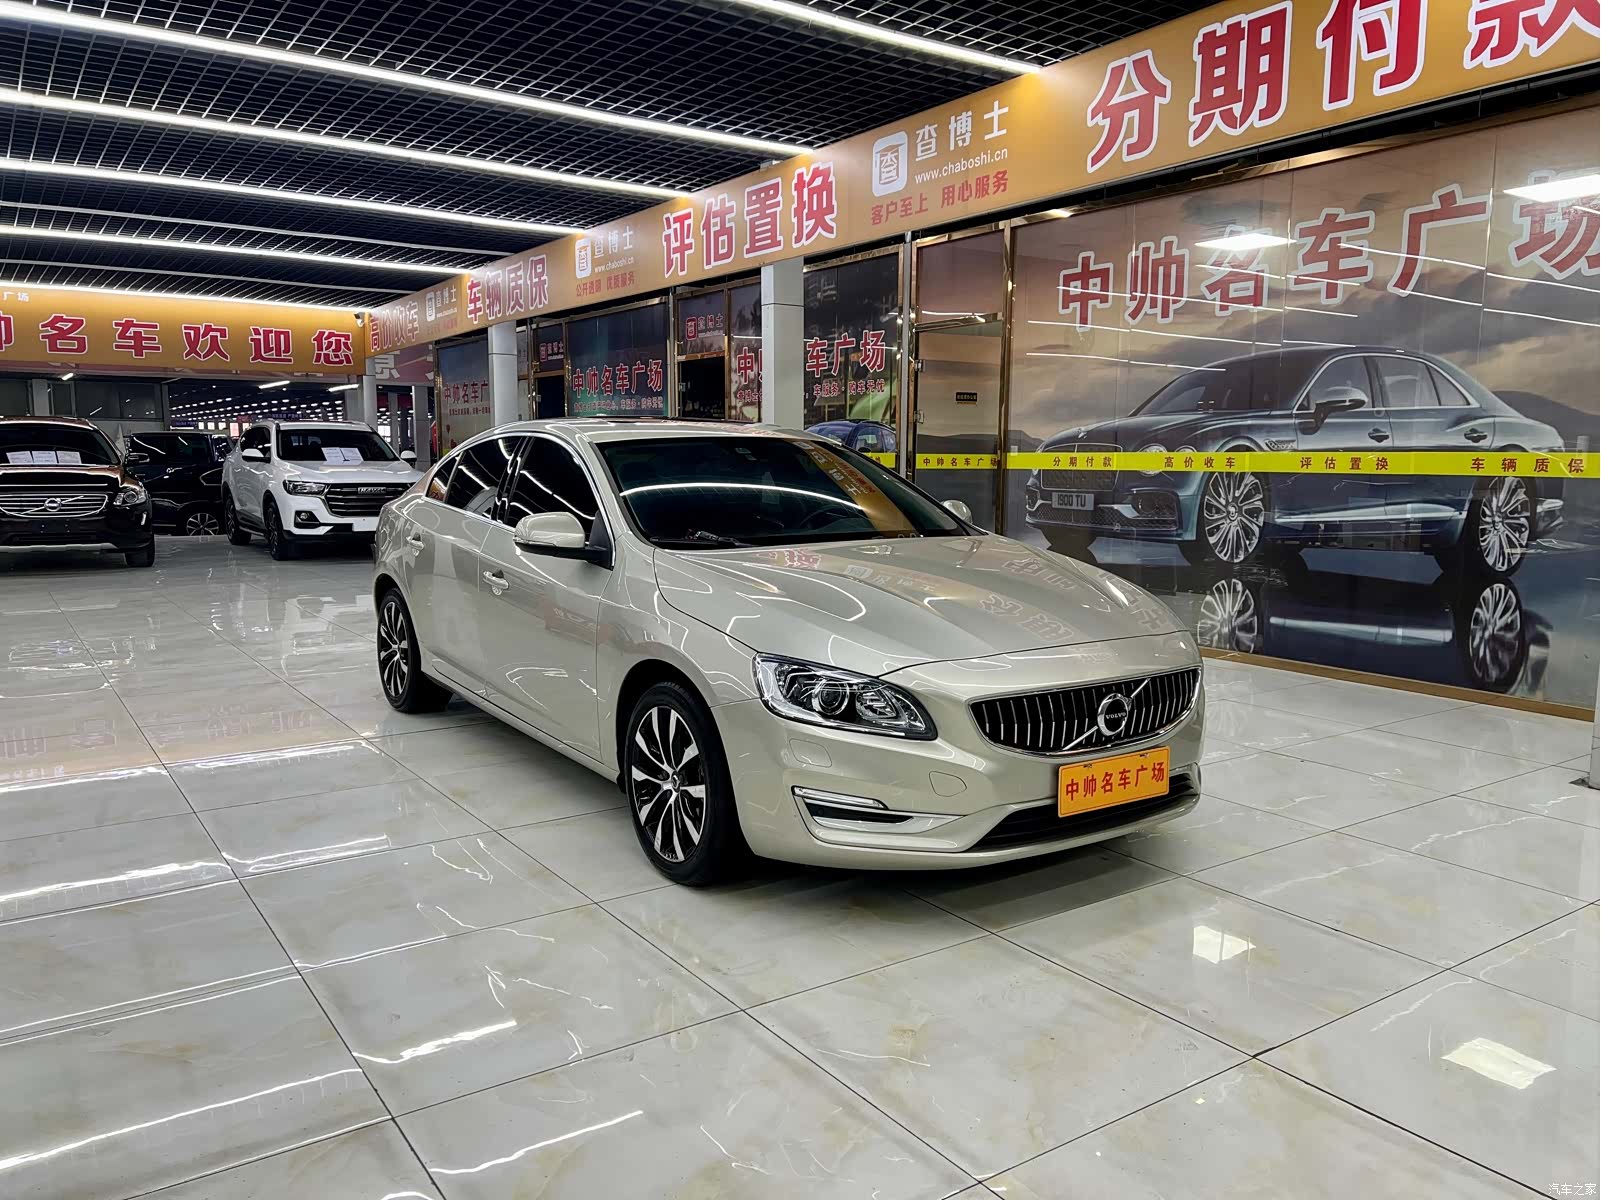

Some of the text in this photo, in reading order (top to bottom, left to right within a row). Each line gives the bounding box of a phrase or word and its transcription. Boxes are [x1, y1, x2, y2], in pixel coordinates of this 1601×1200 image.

[915, 100, 1009, 161] 查博士
[915, 148, 1008, 184] www.chaboshi.cn
[663, 161, 838, 278] 评估置换
[871, 170, 1009, 225] 客户至上 用心服务
[1059, 167, 1600, 332] 中帅名车广场
[467, 254, 548, 324] 车辆质保
[370, 301, 420, 352] 高价收车
[806, 330, 886, 377] 车广场
[572, 359, 663, 398] 中帅名车广场
[1053, 456, 1585, 473] 分期付款 高价收车 评估置换 车辆质保
[1074, 494, 1087, 508] TU
[1105, 711, 1127, 720] VOLVO
[1066, 762, 1165, 801] 中帅名车广场
